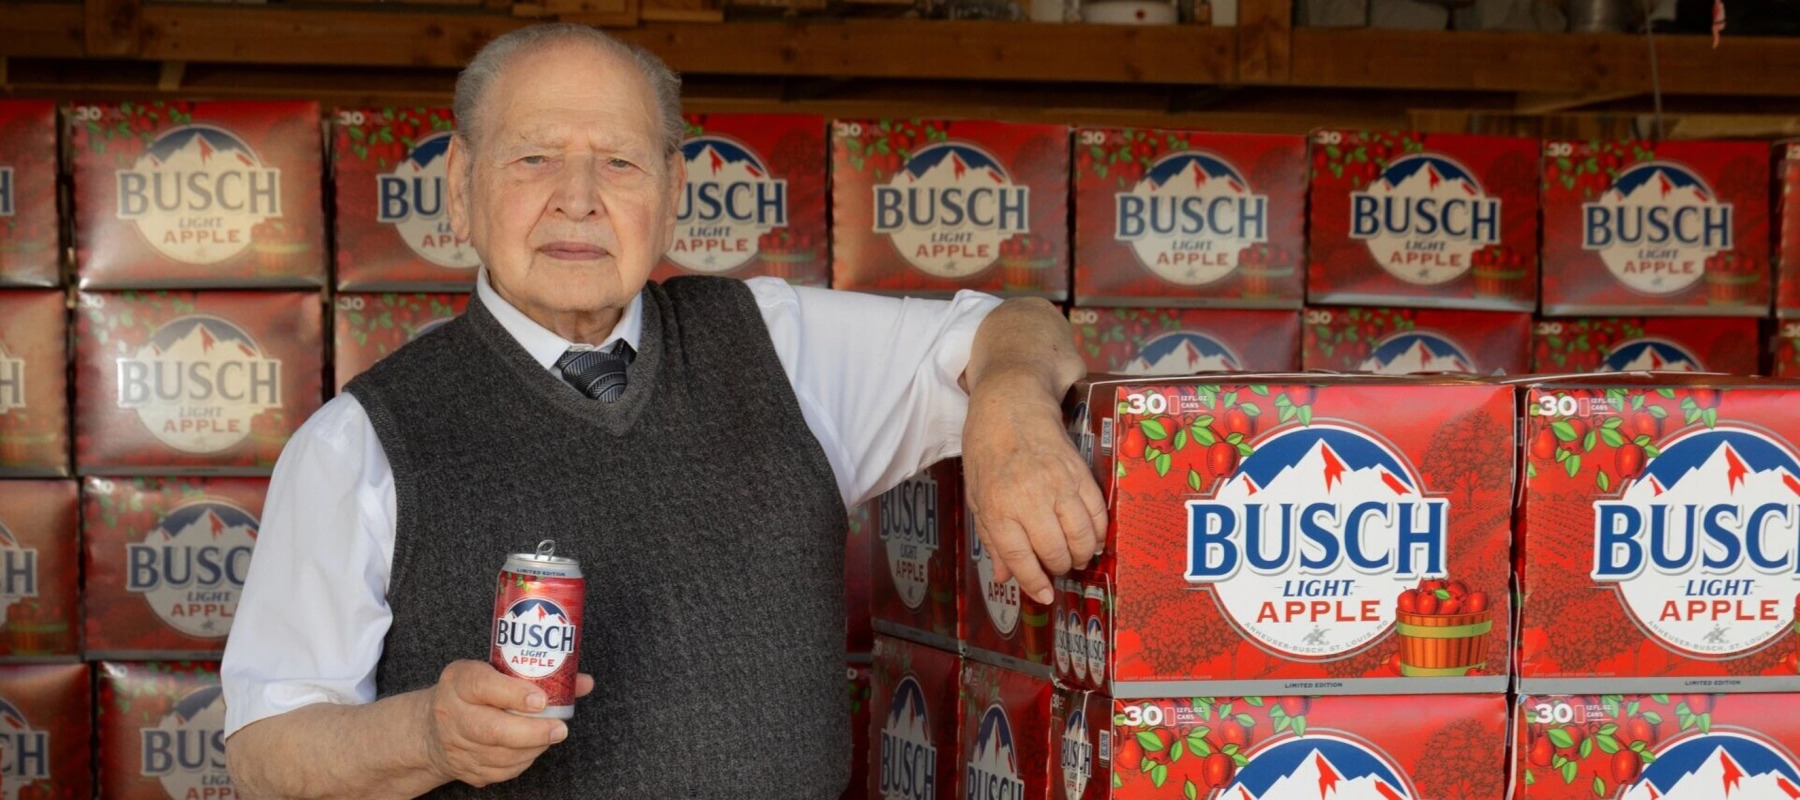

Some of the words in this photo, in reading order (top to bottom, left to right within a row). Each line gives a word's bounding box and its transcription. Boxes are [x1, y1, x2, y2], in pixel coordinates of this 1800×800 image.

[77, 107, 102, 120] 30
[339, 111, 364, 125] 30
[836, 122, 861, 137] 30
[1082, 133, 1105, 145] 30
[1318, 132, 1341, 145] 30
[1549, 143, 1573, 157] 30
[119, 169, 278, 216] BUSCH
[676, 181, 786, 224] SCH
[876, 186, 1025, 230] BUSCH
[178, 217, 223, 228] LIGHT
[1118, 194, 1265, 239] BUSCH
[1353, 195, 1496, 240] BUSCH
[689, 226, 731, 237] LIGHT
[1586, 204, 1730, 248] BUSCH
[163, 229, 241, 244] APPLE
[931, 233, 973, 244] LIGHT
[674, 238, 748, 252] APPLE
[915, 244, 990, 259] APPLE
[1172, 240, 1213, 251] LIGHT
[1405, 240, 1446, 251] LIGHT
[1156, 252, 1229, 266] APPLE
[1390, 251, 1462, 266] APPLE
[1638, 249, 1678, 260] LIGHT
[1624, 260, 1695, 274] APPLE
[340, 296, 364, 310] 30
[1073, 311, 1097, 324] 30
[1307, 311, 1331, 324] 30
[1538, 322, 1562, 335] 30
[121, 359, 278, 405] BUSCH
[1126, 393, 1167, 414] 30
[1538, 395, 1577, 416] 30
[178, 406, 223, 418] LIGHT
[162, 419, 241, 433] APPLE
[881, 480, 937, 546] BUSCH
[1189, 501, 1444, 577] BUSCH
[1595, 502, 1800, 575] BUSC
[129, 545, 254, 589] BUSC
[896, 560, 924, 583] APPLE
[987, 581, 1017, 606] APPLE
[1282, 579, 1355, 597] LIGHT
[1685, 579, 1755, 596] LIGHT
[187, 591, 233, 602] LIGHT
[170, 603, 236, 617] APPL
[1256, 600, 1381, 623] APPLE
[1659, 599, 1780, 622] APPLE
[496, 618, 575, 652] BUSCH
[520, 649, 548, 658] LIGHT
[511, 656, 555, 667] APPLE
[1123, 705, 1163, 727] 30
[1535, 703, 1573, 724] 30
[144, 729, 226, 774] BUS
[881, 733, 937, 800] BUSCH
[202, 774, 231, 786] LIG
[186, 787, 240, 800] APP
